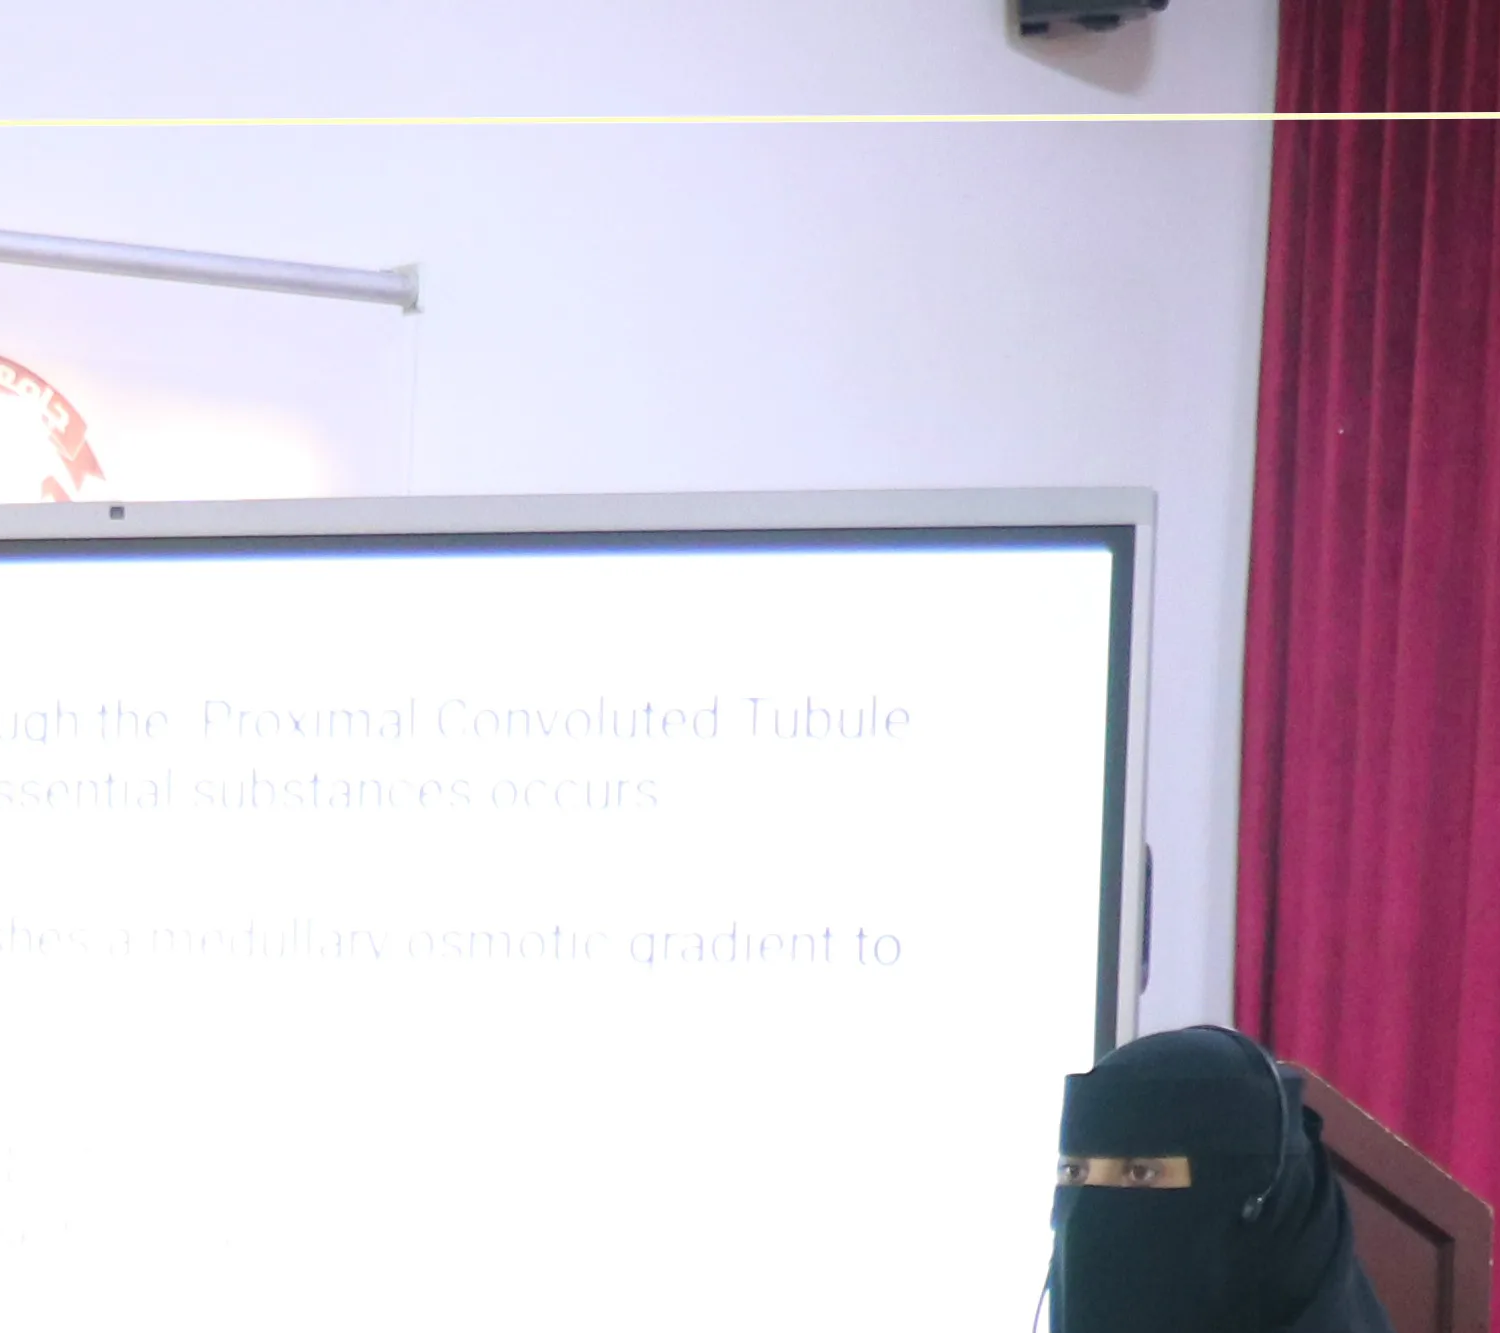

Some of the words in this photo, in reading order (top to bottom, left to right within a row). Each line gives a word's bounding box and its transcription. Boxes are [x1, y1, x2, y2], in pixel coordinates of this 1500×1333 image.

[96, 701, 170, 742] the
[202, 697, 417, 741] Proximal
[436, 696, 720, 742] Convoluted
[740, 695, 914, 740] Tubule
[193, 766, 472, 812] substances
[628, 920, 836, 974] gradient
[853, 923, 905, 968] to
